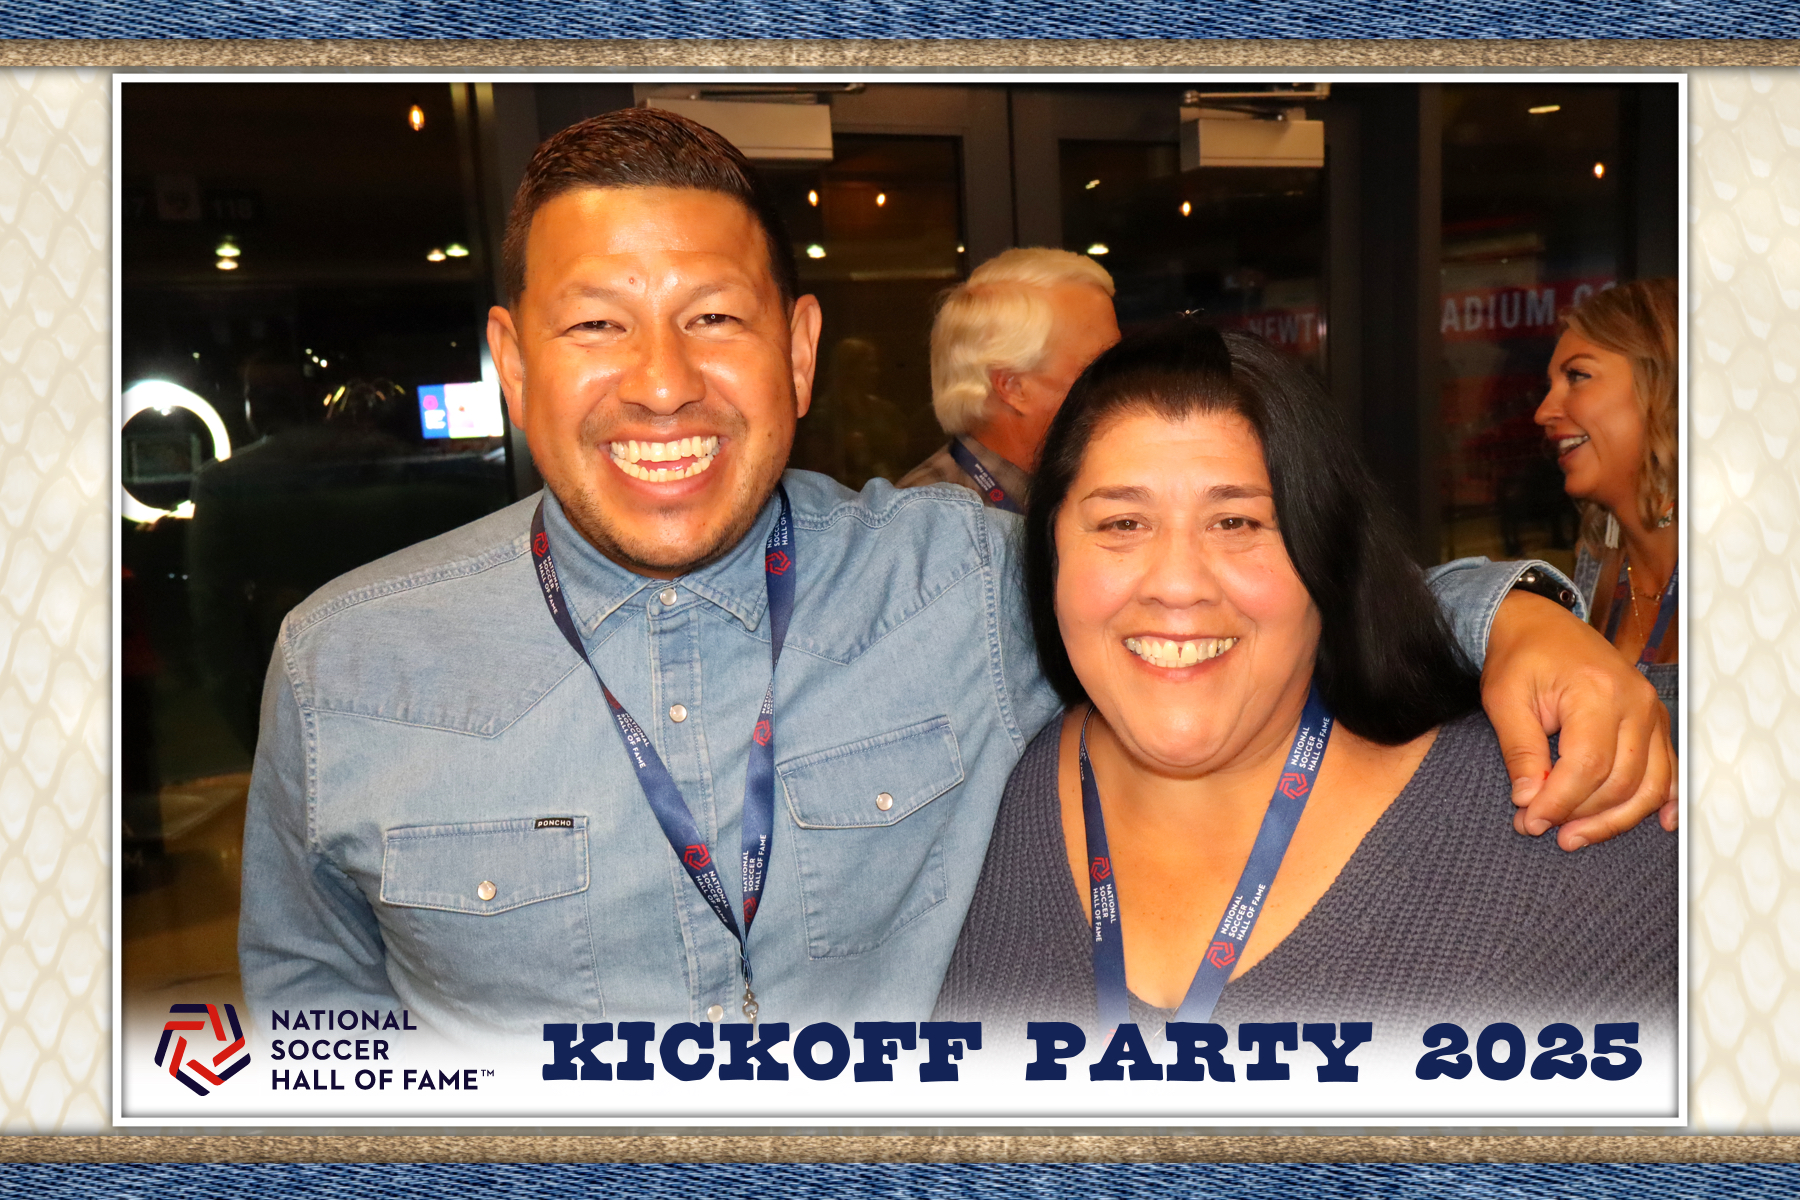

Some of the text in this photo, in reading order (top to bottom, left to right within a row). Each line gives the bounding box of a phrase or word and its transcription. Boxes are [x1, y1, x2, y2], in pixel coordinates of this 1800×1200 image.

[781, 526, 789, 546] HALL
[538, 563, 546, 583] HALL
[542, 559, 554, 590] SOCCER
[547, 555, 560, 593] NATIONAL
[616, 714, 647, 769] HALL OF FAME
[621, 713, 641, 743] SOCCER
[625, 712, 650, 748] NATIONAL
[1307, 716, 1330, 772] HALL OF FAME
[1291, 726, 1310, 766] NATIONAL
[1299, 735, 1316, 769] SOCCER
[537, 819, 572, 827] PONCHO
[748, 857, 756, 892] SOCCER
[754, 834, 767, 891] HALL OF FAME
[695, 875, 709, 894] HALL
[702, 872, 721, 903] SOCCER
[708, 870, 729, 909] NATIONAL
[1099, 885, 1109, 918] SOCCER
[1094, 909, 1102, 920] OF
[1106, 883, 1116, 924] NATIONAL
[1220, 894, 1244, 935] NATIONAL
[1228, 903, 1248, 938] SOCCER
[1236, 883, 1266, 941] HALL OF FAME
[1095, 921, 1103, 942] FAME
